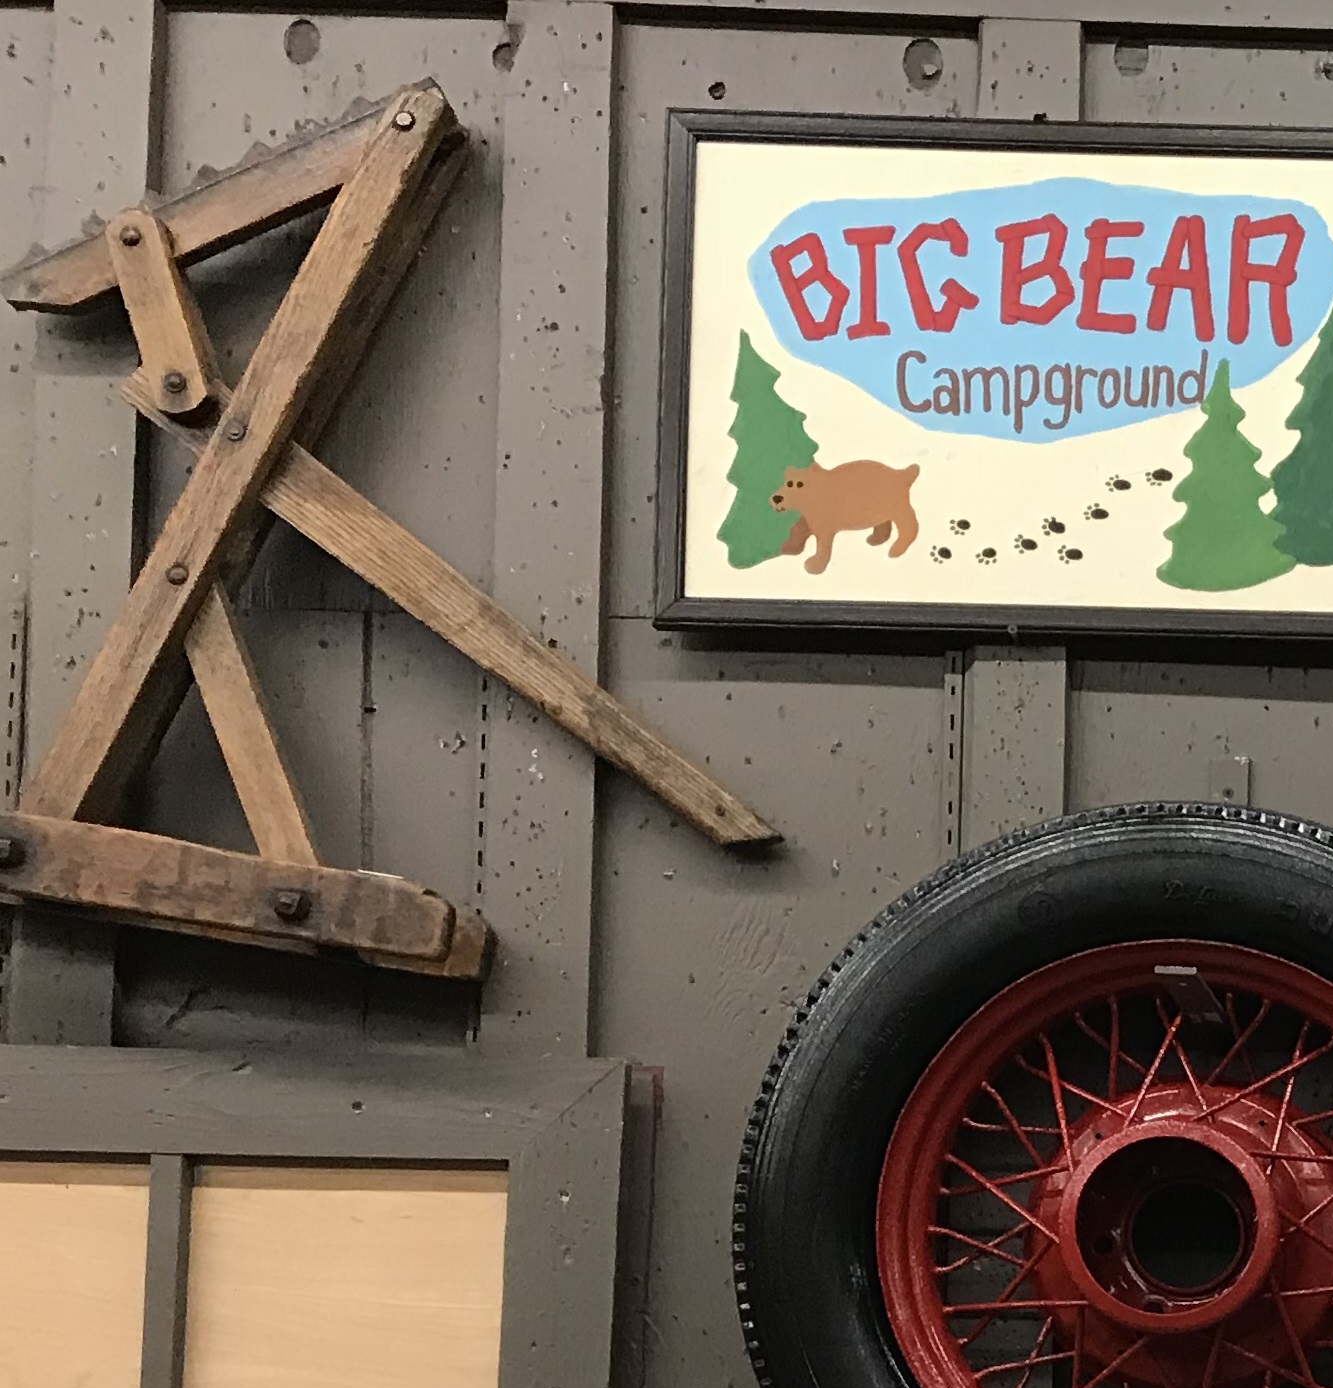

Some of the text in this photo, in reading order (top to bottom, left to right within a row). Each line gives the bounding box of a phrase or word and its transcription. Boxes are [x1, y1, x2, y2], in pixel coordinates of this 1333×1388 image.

[769, 213, 1306, 347] BIG BEAR
[896, 349, 1207, 434] Campground
